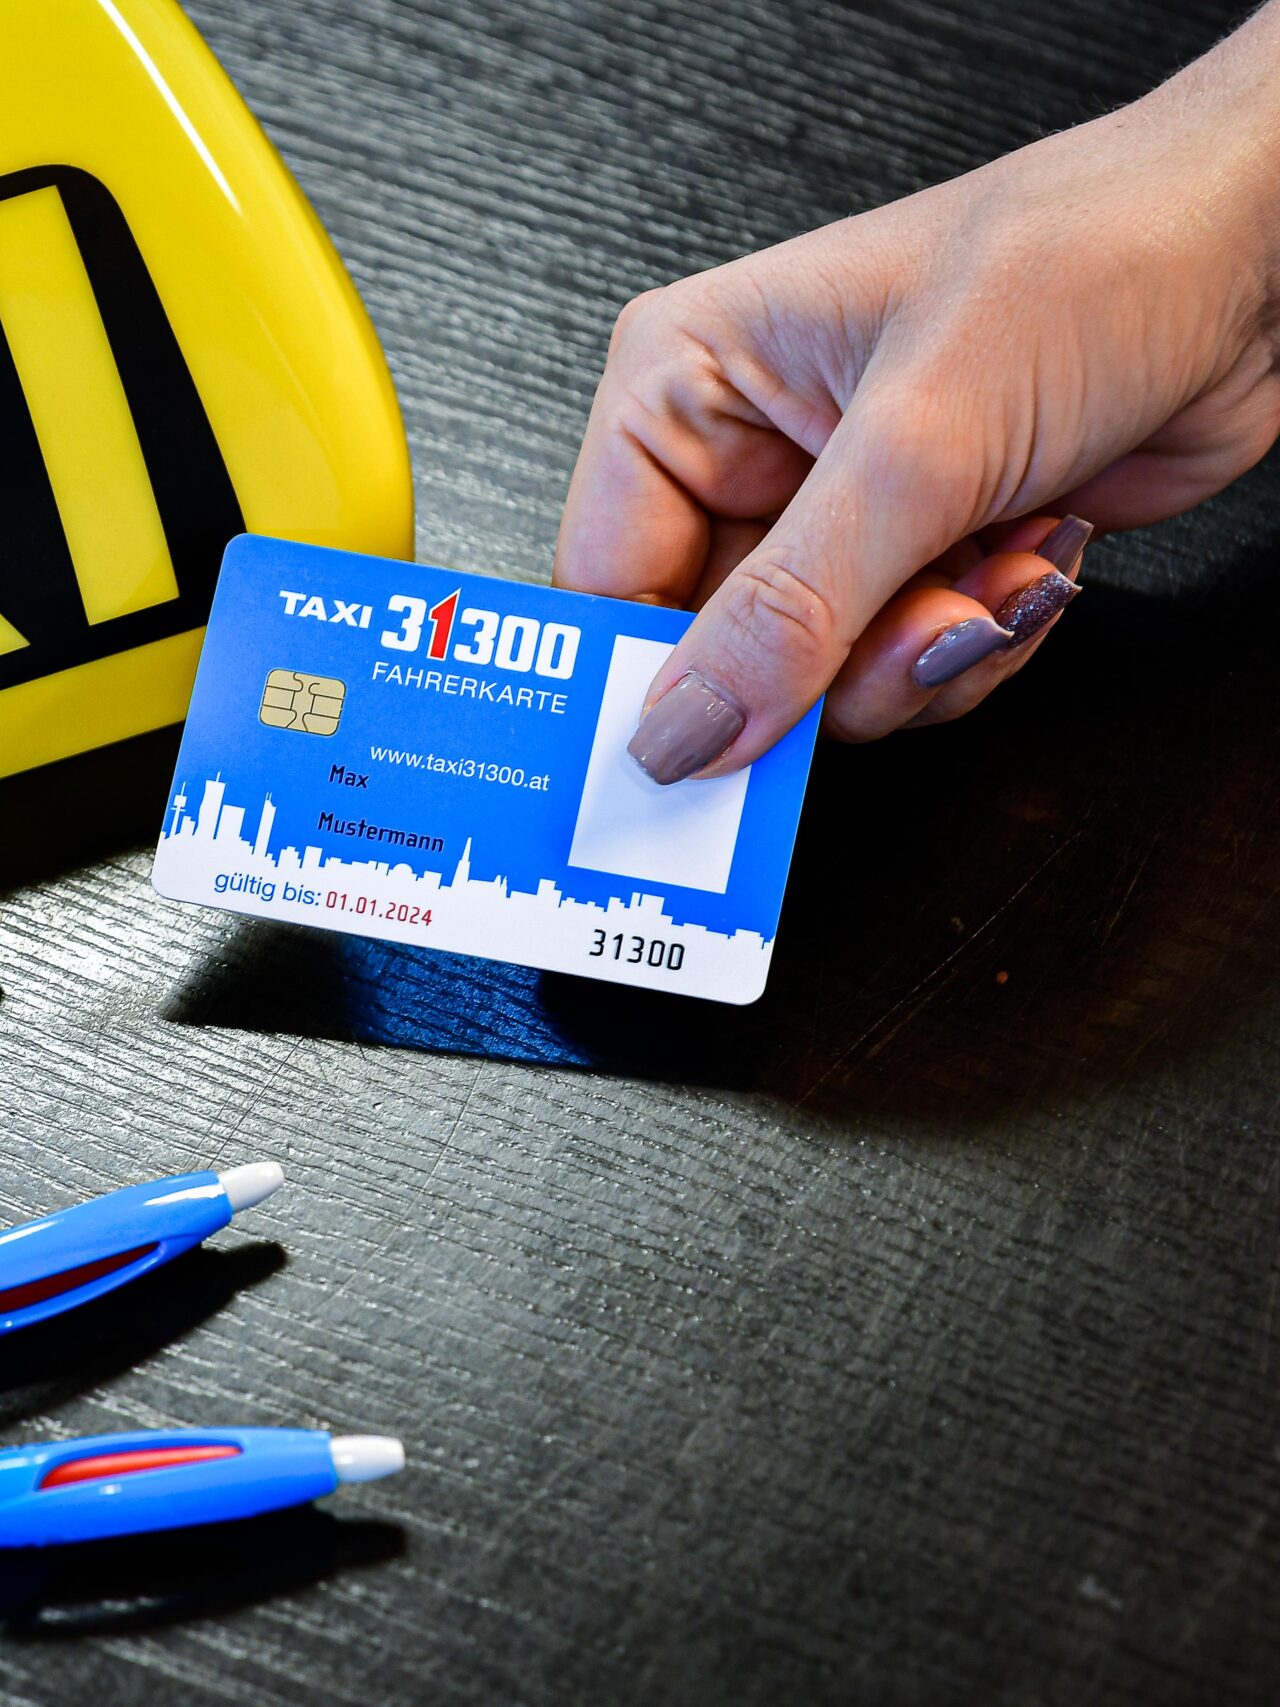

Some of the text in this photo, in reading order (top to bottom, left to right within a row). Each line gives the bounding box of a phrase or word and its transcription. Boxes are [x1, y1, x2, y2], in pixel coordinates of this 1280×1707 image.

[278, 586, 582, 681] TAXI 31300
[372, 661, 569, 715] FAHRERKARTE
[328, 764, 370, 790] Max
[370, 746, 551, 792] www.taxi31300.at
[317, 811, 445, 853] Mustermann
[213, 870, 434, 927] gültig bis: 01.01.2024
[588, 928, 686, 971] 31300
